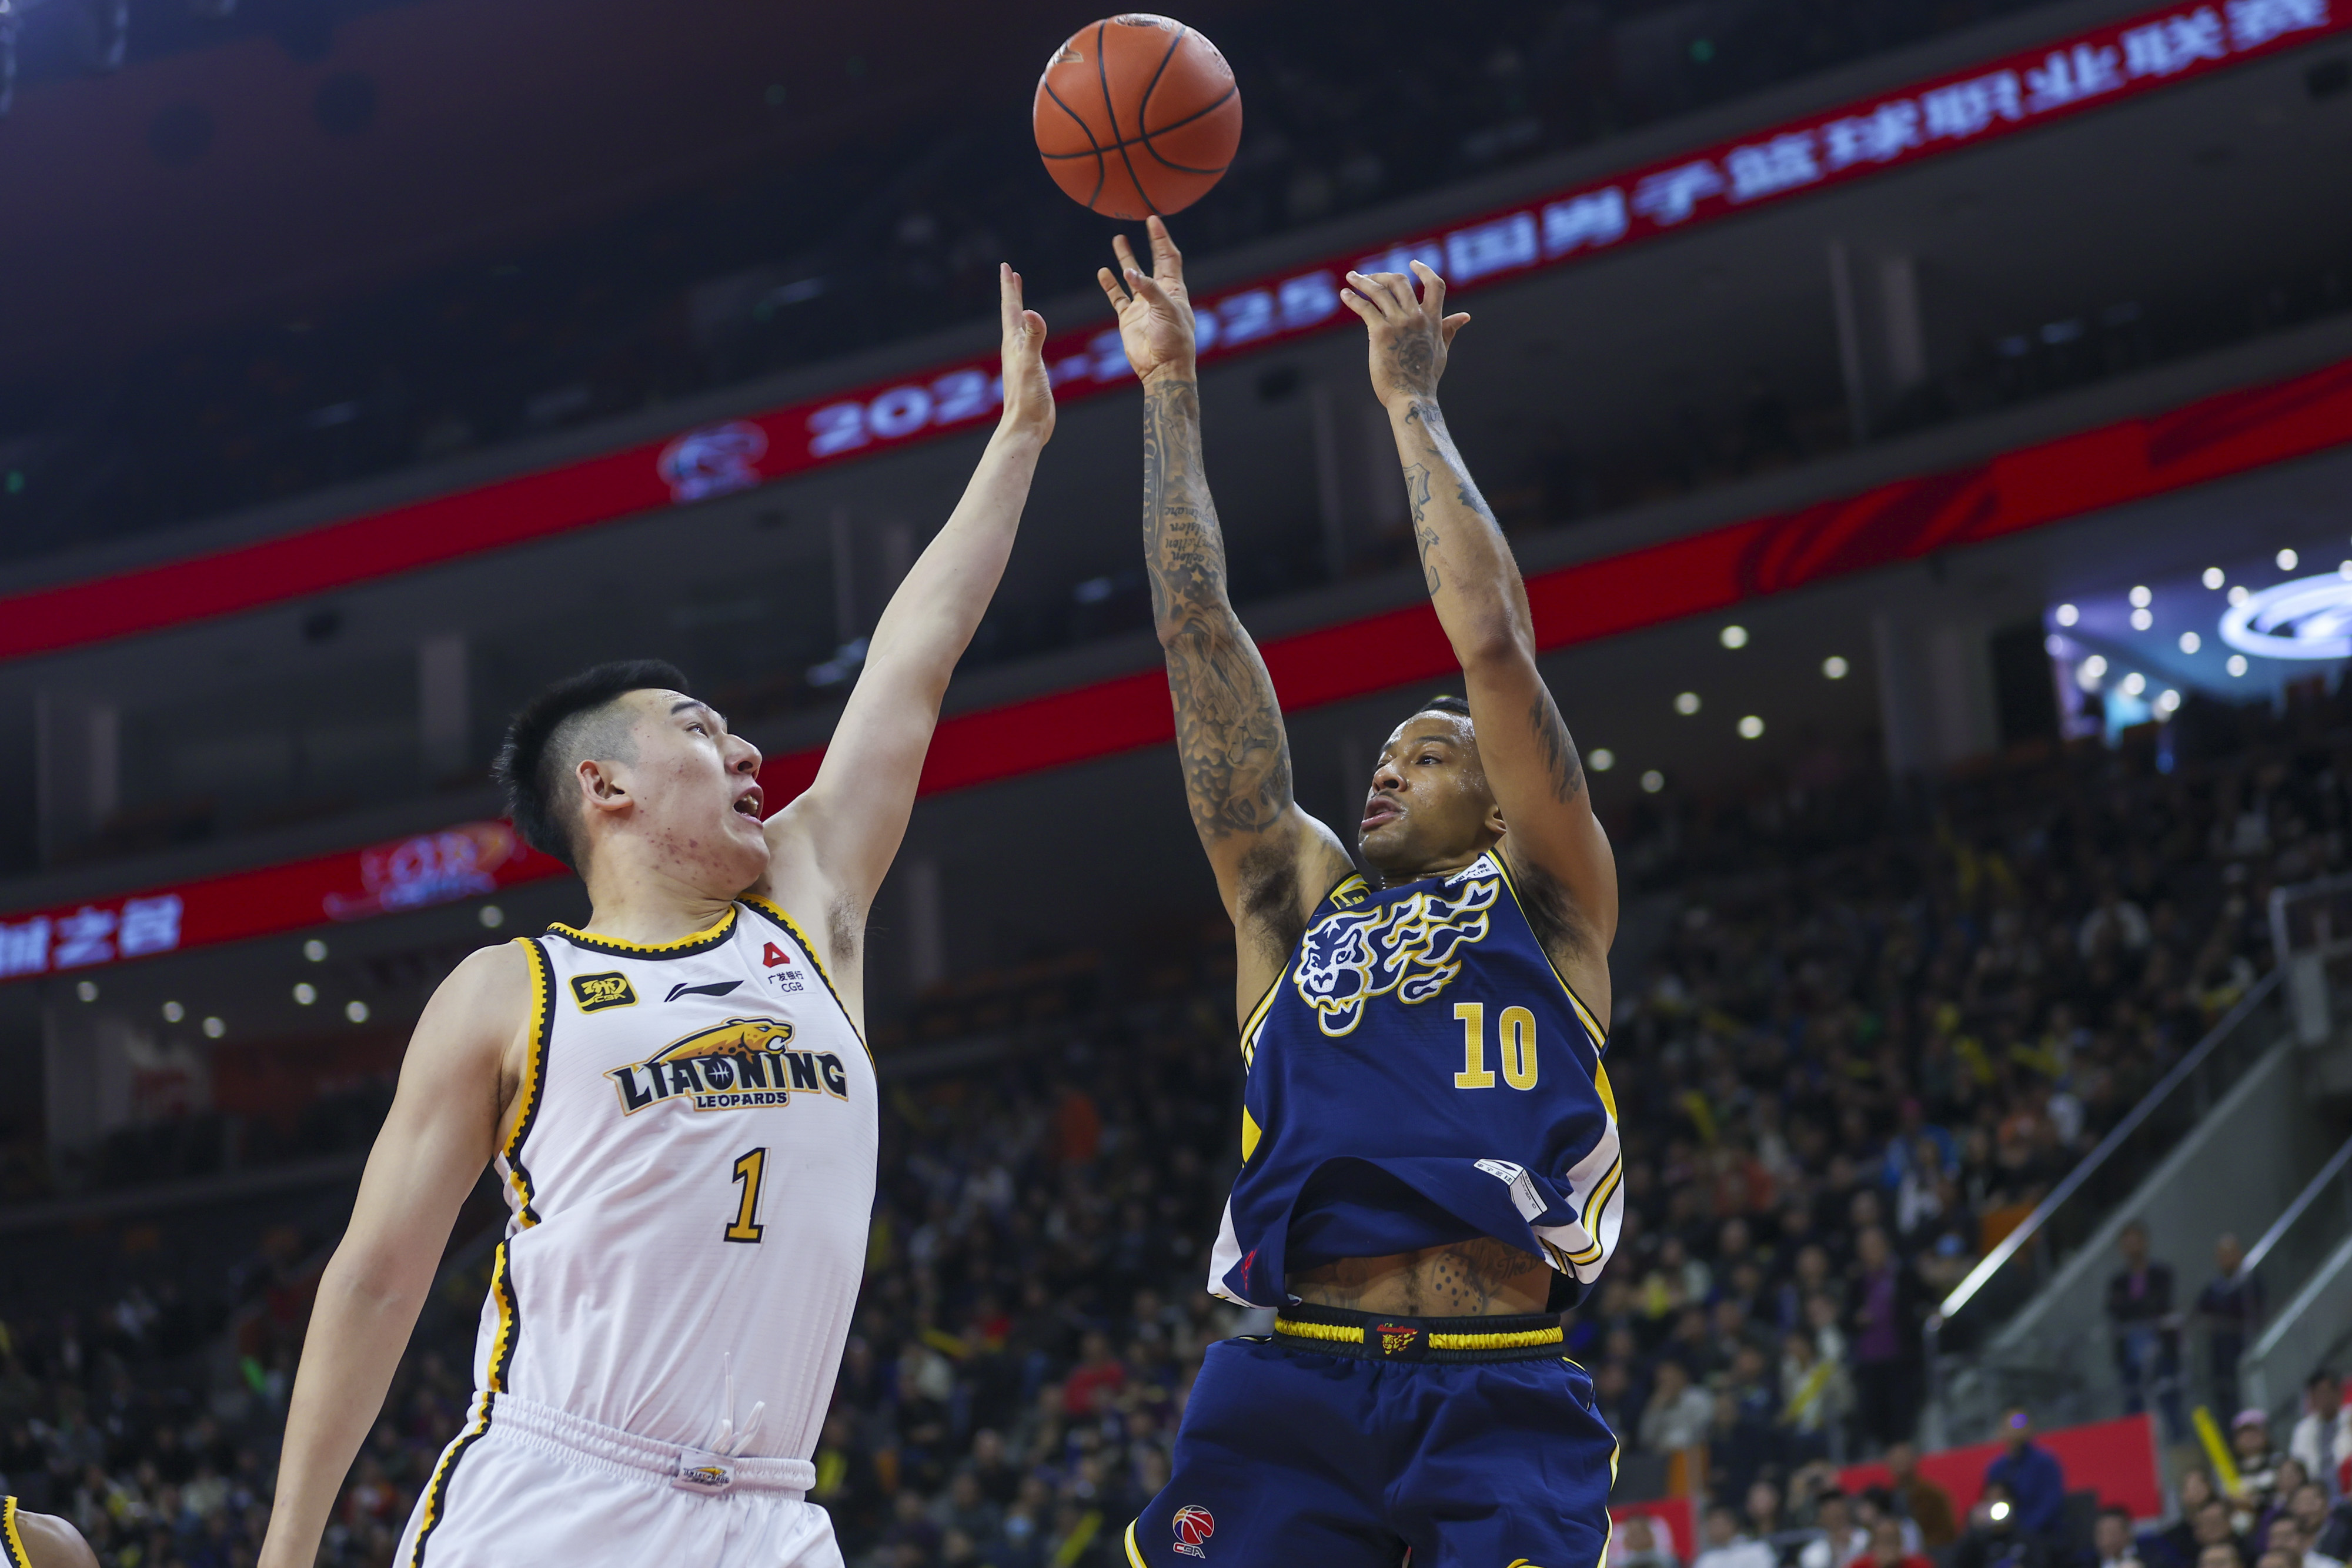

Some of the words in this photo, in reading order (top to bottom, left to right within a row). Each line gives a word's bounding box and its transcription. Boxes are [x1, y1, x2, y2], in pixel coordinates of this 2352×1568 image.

[806, 269, 1339, 457] 202-225
[767, 971, 804, 984] 广发银行
[781, 982, 804, 992] CGB
[1454, 1002, 1538, 1091] 10
[606, 1051, 848, 1114] LIAONING
[696, 1091, 788, 1109] LEOPARDS
[724, 1148, 769, 1243] 1
[1173, 1542, 1205, 1559] CBA
